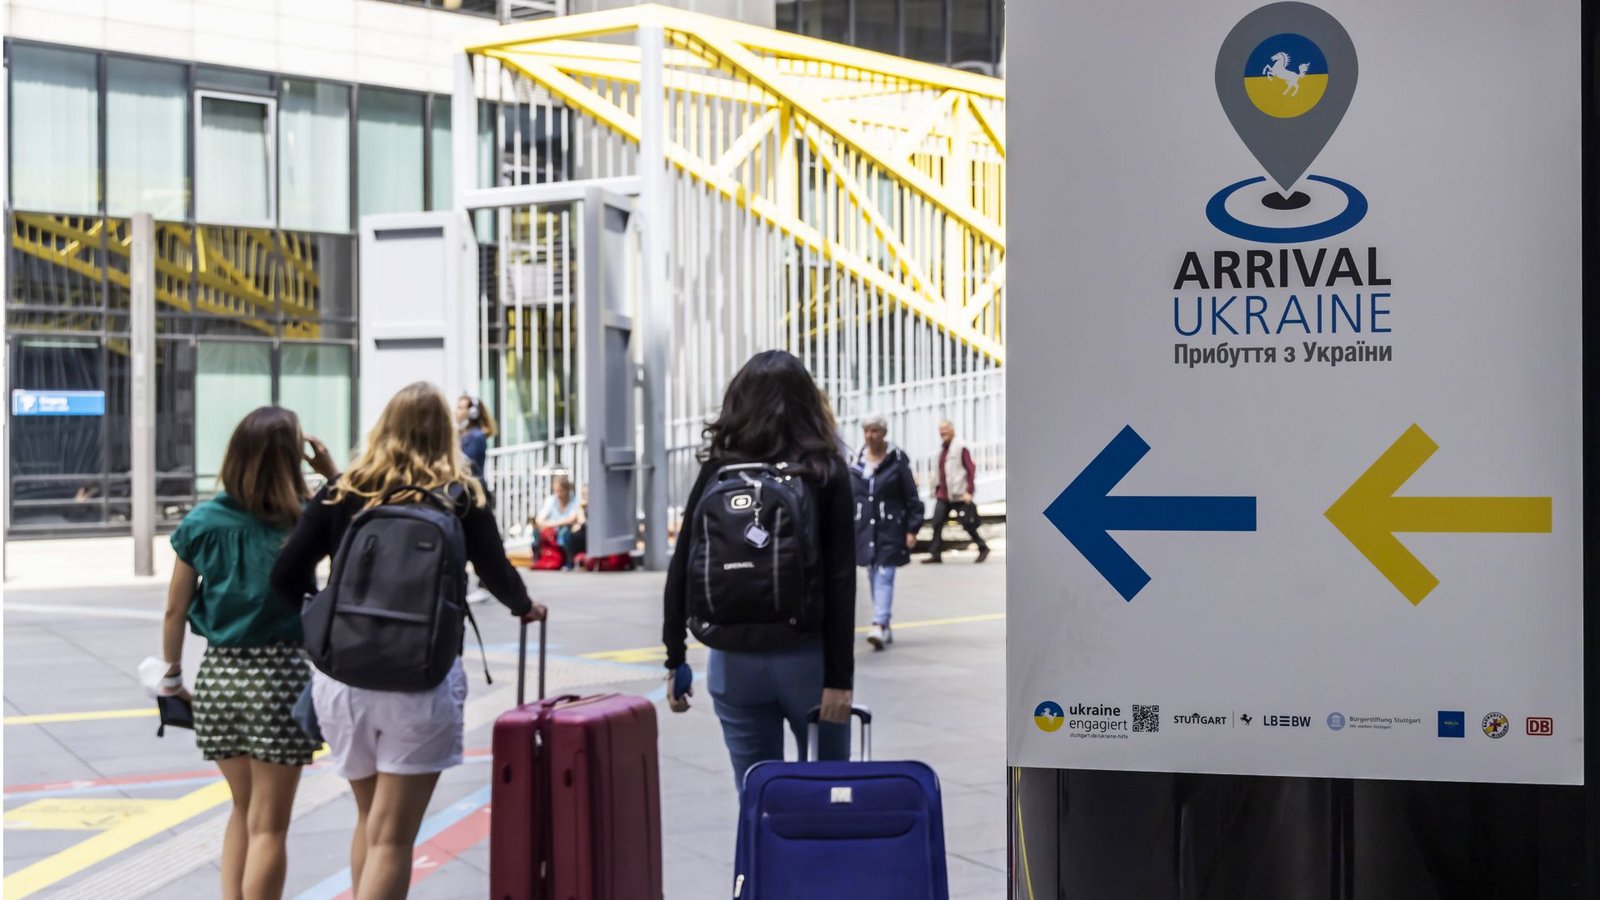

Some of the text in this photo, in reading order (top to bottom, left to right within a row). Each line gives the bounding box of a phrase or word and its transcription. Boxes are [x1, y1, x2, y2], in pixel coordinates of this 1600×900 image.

[1173, 247, 1392, 290] ARRIVAL
[1173, 293, 1392, 336] UKRAINE
[1174, 341, 1393, 369] Прибуття з України
[1069, 703, 1121, 716] ukraine
[1069, 718, 1128, 733] engagiert
[1173, 713, 1227, 725] STUTTGART
[1394, 717, 1421, 725] Stuttgart
[1530, 720, 1550, 733] DB
